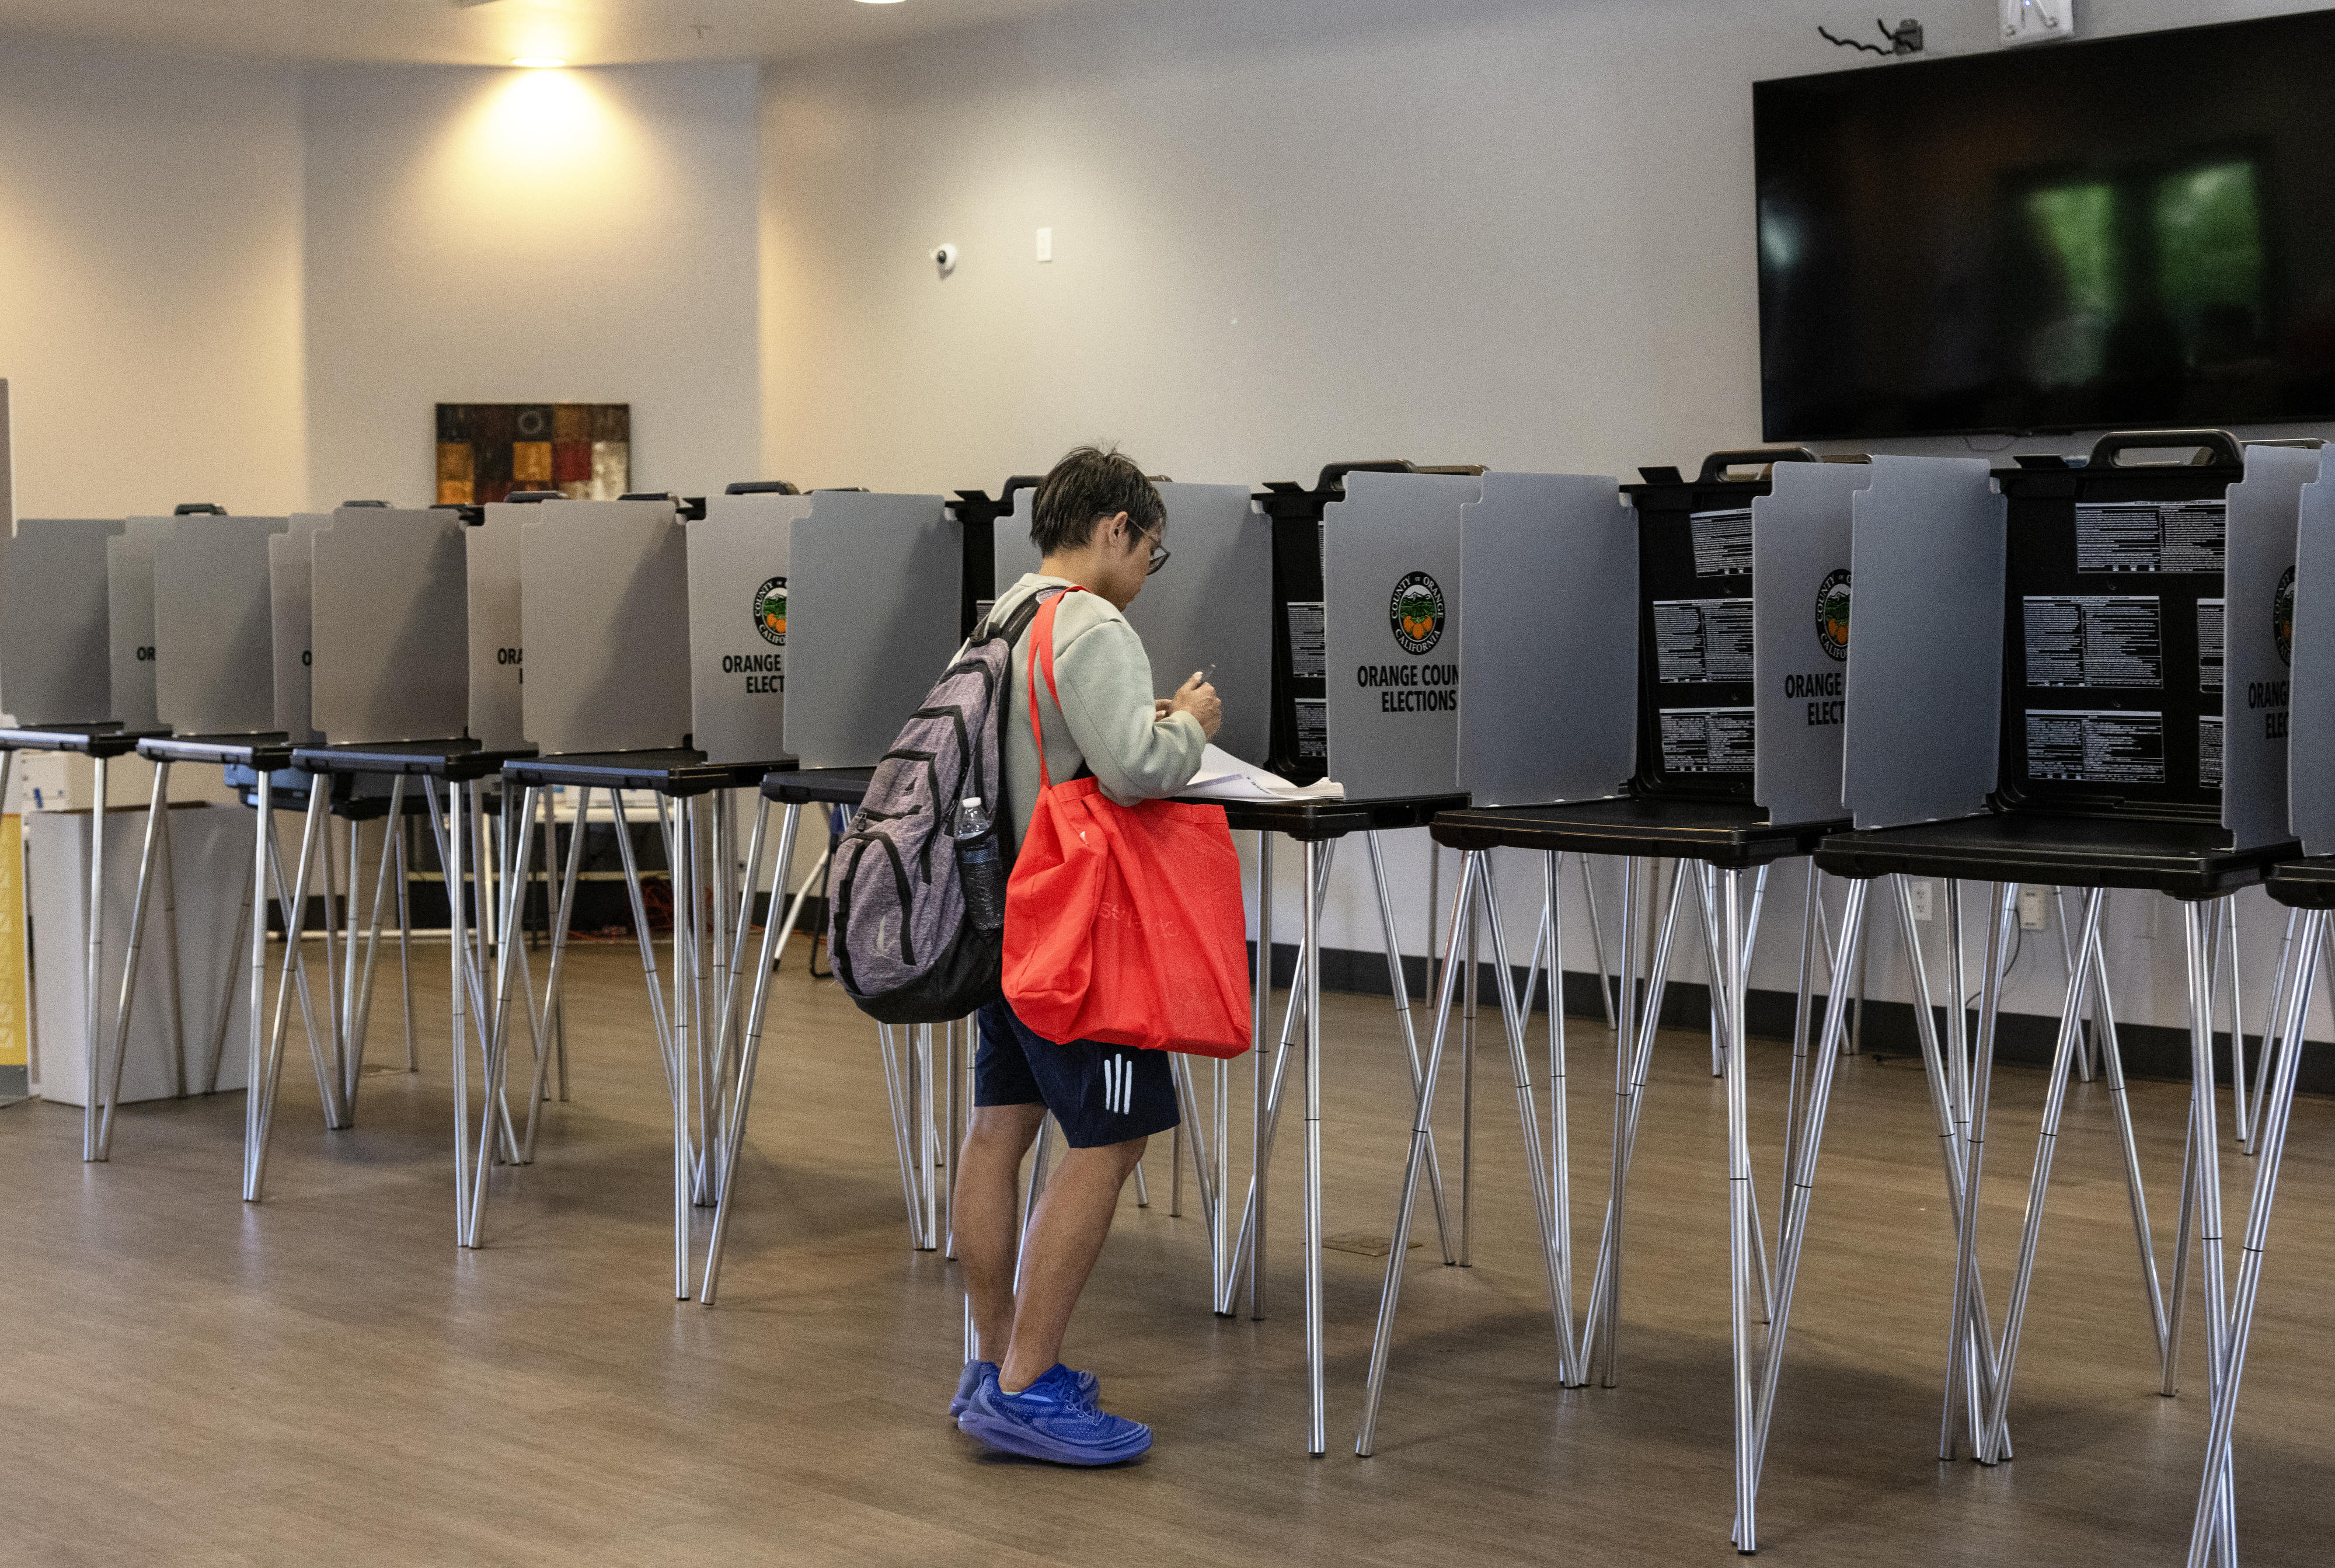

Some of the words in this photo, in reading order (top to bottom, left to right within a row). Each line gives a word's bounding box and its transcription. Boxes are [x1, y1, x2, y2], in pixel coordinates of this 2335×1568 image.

[755, 581, 773, 617] COUNTY
[1391, 576, 1411, 619] COUNTY
[1423, 576, 1444, 618] ORANGE
[1817, 574, 1835, 622] COUNTY
[1395, 629, 1441, 653] CALIFORNIA
[722, 654, 781, 673] ORANGE
[1357, 664, 1418, 688] ORANGE
[1785, 672, 1842, 699] ORANGE
[1382, 689, 1457, 712] ELECTIONS
